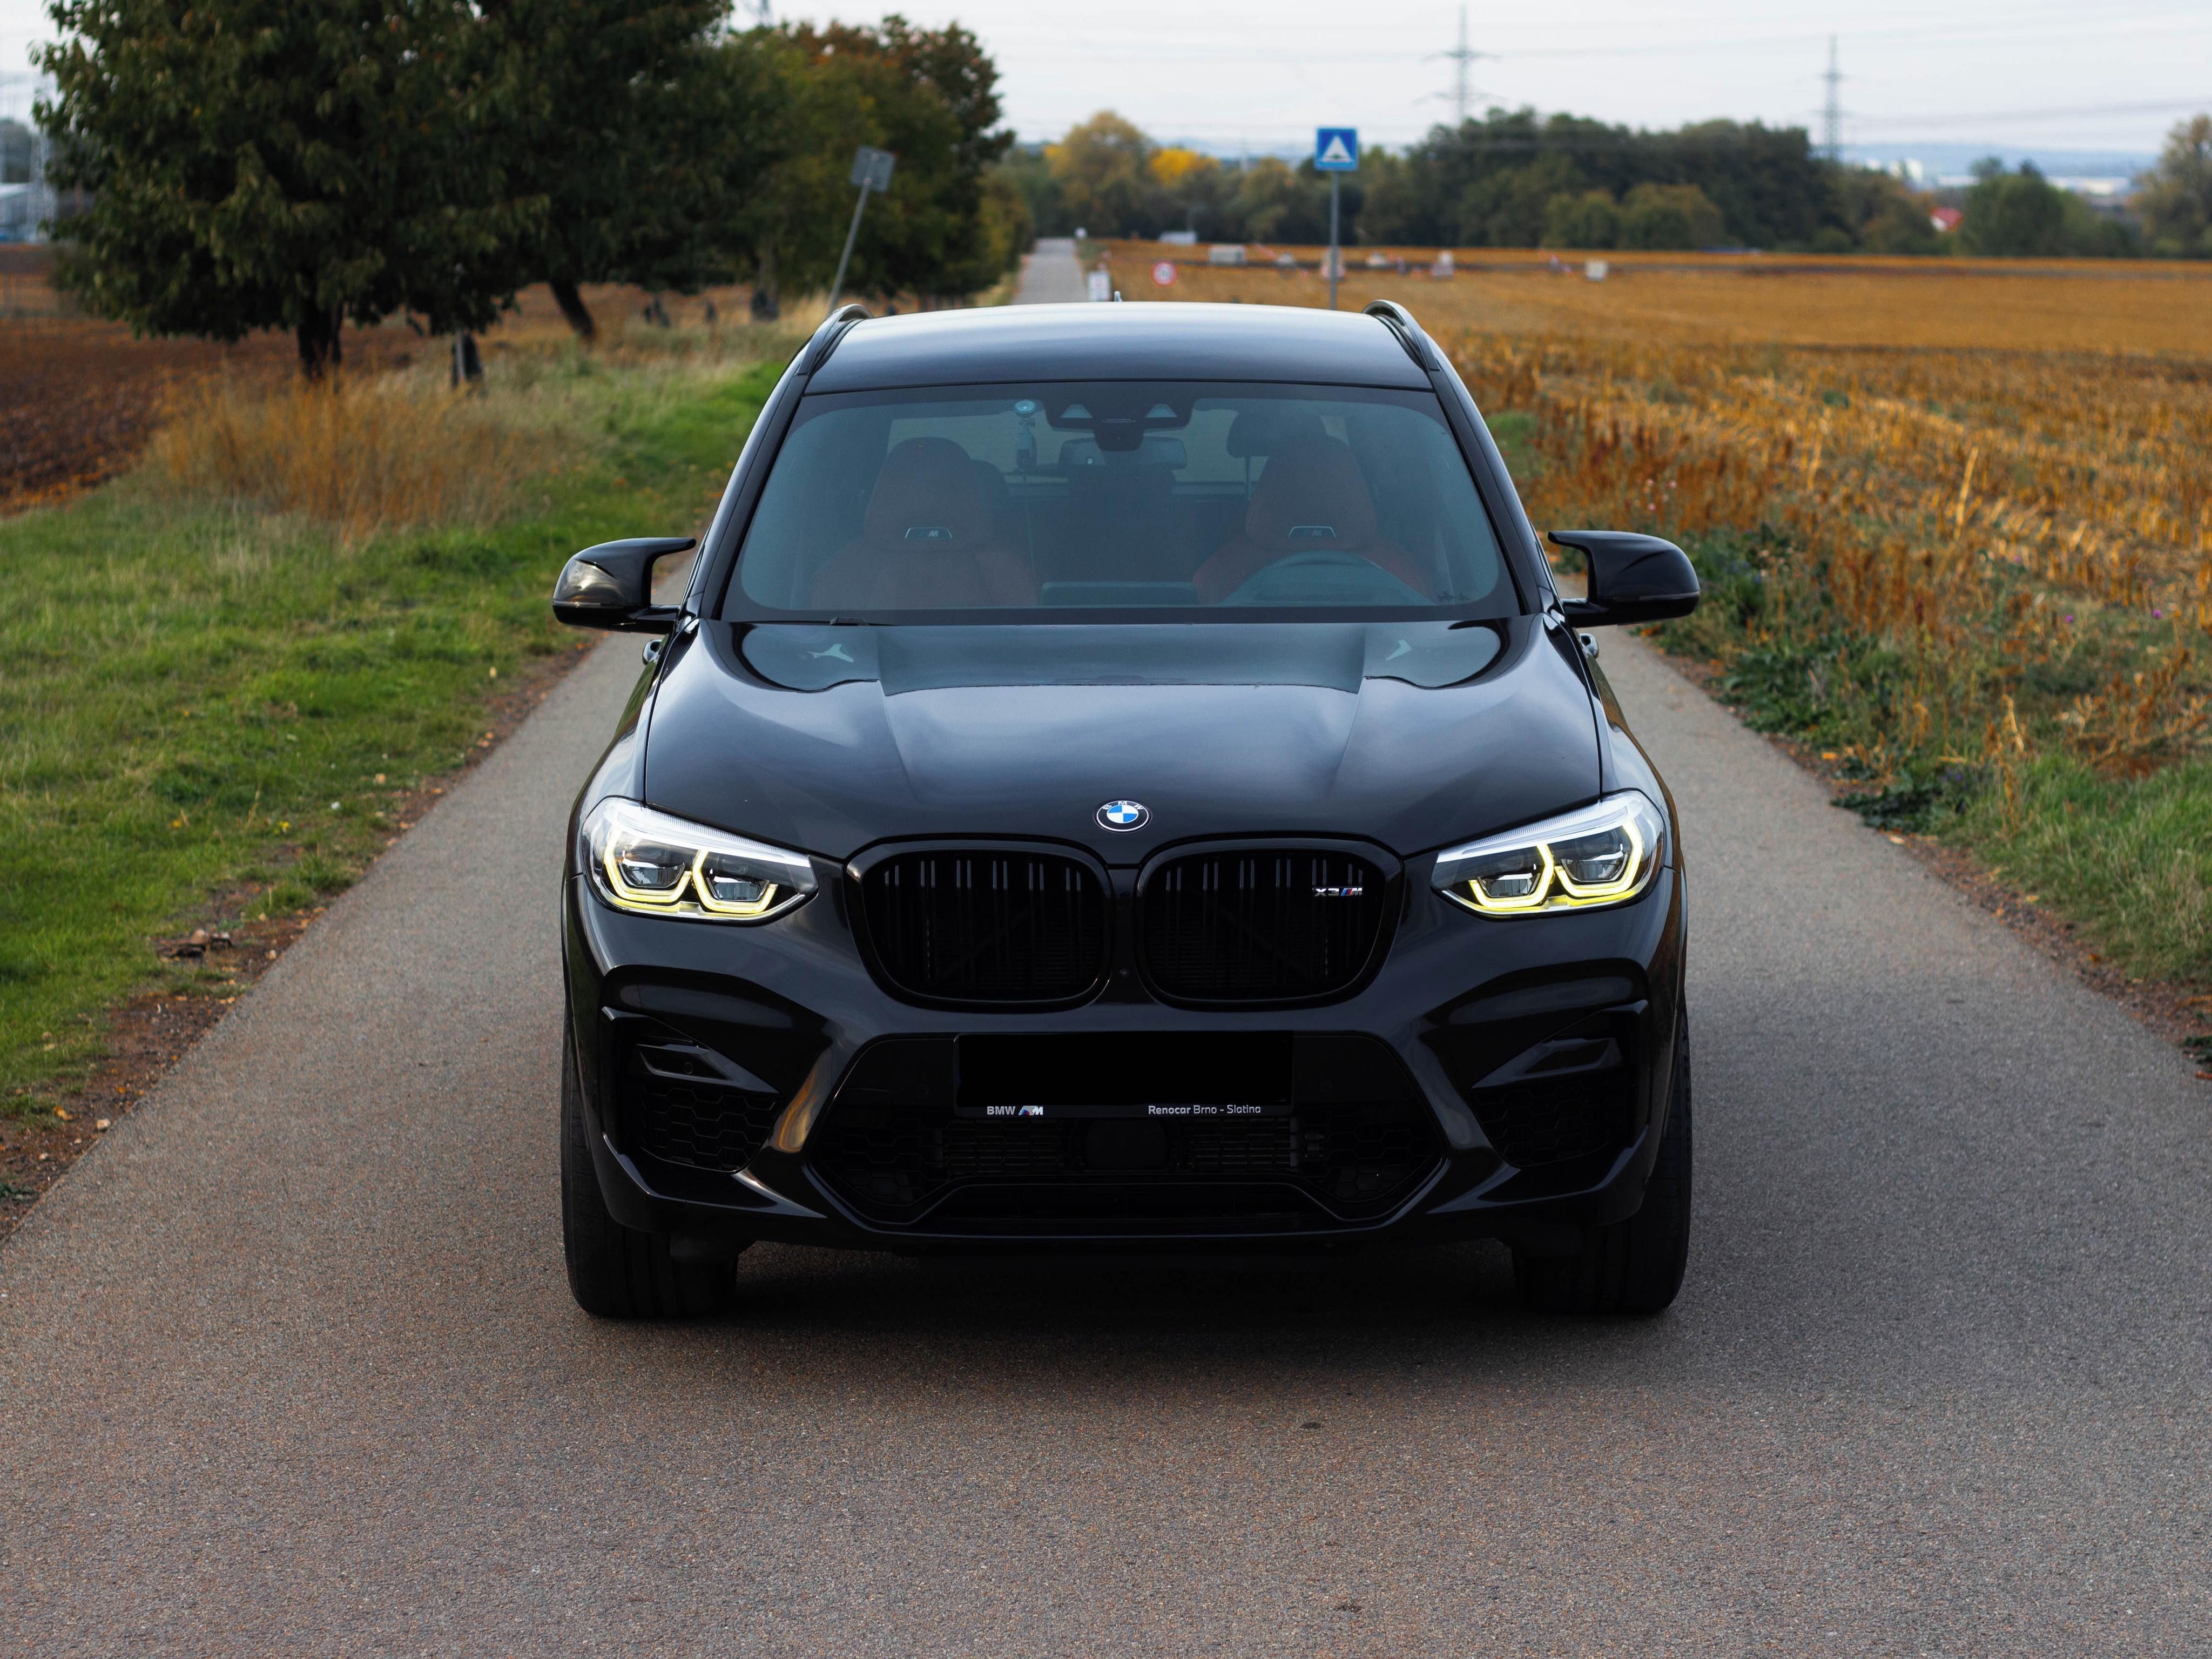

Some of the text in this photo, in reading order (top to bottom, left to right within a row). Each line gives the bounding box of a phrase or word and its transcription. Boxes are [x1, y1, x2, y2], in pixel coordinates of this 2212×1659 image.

[1102, 801, 1144, 810] BMW
[987, 1106, 1015, 1115] BMW
[1148, 1105, 1191, 1115] Renocar
[1193, 1105, 1217, 1114] Brno
[1226, 1104, 1261, 1114] Slatina
